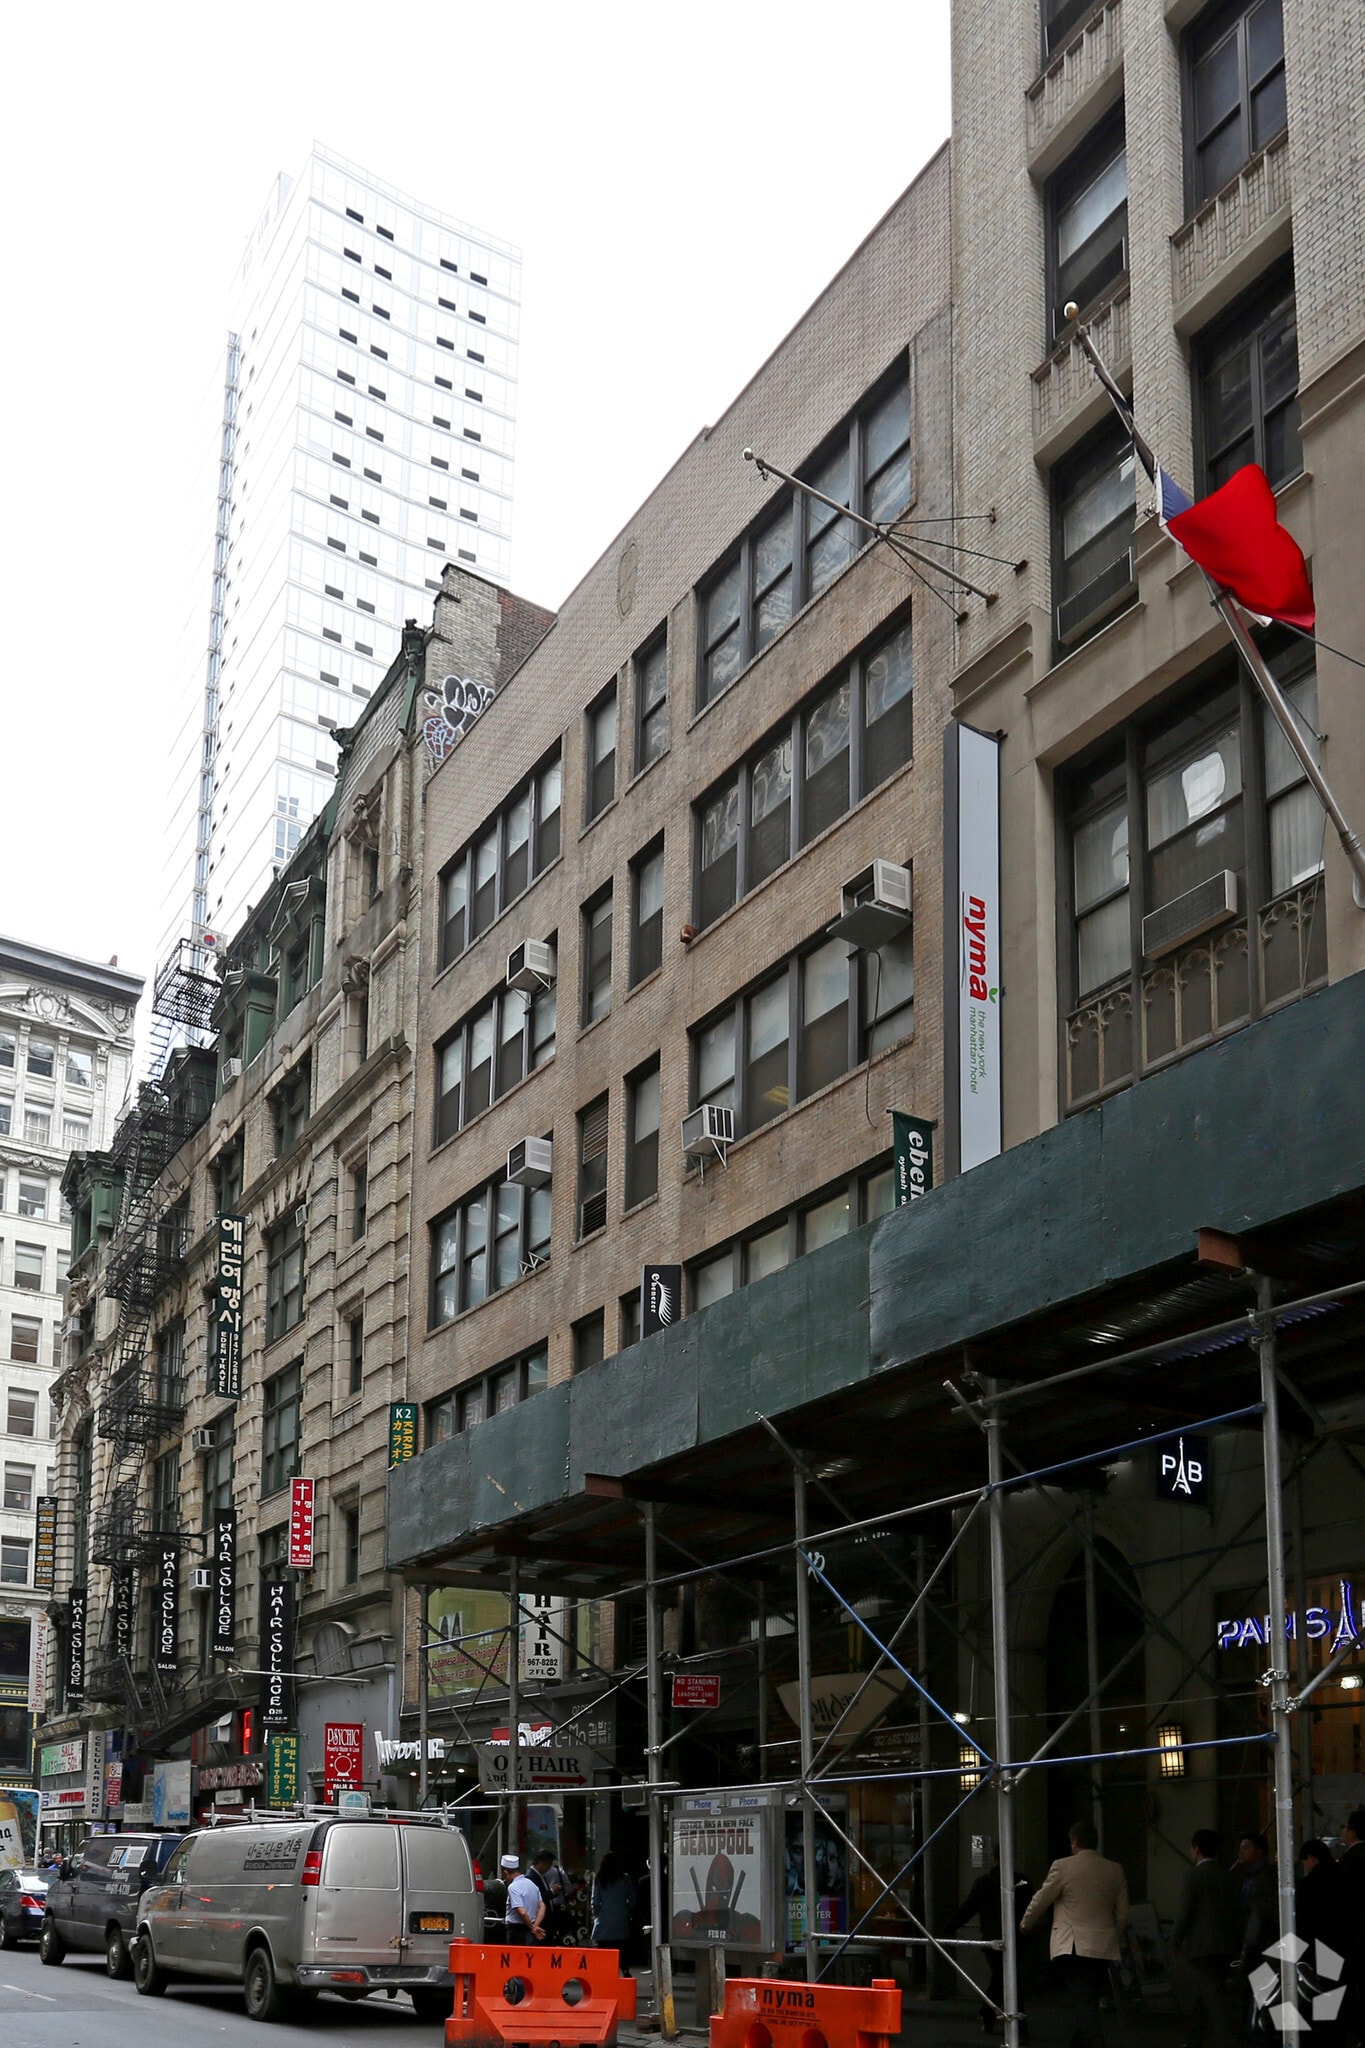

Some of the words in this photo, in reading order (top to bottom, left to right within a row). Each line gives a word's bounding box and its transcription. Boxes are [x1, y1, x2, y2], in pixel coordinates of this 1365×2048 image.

[978, 1010, 986, 1028] the
[970, 1065, 978, 1094] hotel
[978, 1052, 987, 1078] york
[899, 1156, 908, 1190] eyelash
[219, 1219, 242, 1331] 에덴여행사
[219, 1358, 227, 1392] TRAVEL
[403, 1422, 413, 1461] KARAO
[220, 1523, 232, 1562] HAIR
[163, 1553, 175, 1588] HAIR
[72, 1600, 82, 1629] HAIR
[219, 1568, 231, 1635] COLLAGE
[270, 1586, 283, 1628] HAIR
[117, 1614, 128, 1654] COLLA
[162, 1593, 174, 1654] COLLAGE
[534, 1595, 552, 1656] HAIR
[71, 1634, 82, 1685] COLLAGE
[270, 1633, 283, 1706] COLLAGE
[62, 1744, 74, 1756] SALE
[327, 1728, 360, 1746] PSYCHIC
[415, 1738, 445, 1760] BR
[93, 1736, 101, 1781] CELLULAR
[284, 1737, 296, 1796] 에덴여행사
[529, 1756, 580, 1773] HAIR
[91, 1786, 99, 1814] PHONE
[694, 1800, 711, 1808] Phone
[739, 1797, 758, 1806] Phone
[704, 1820, 715, 1828] HAS
[717, 1820, 721, 1828] A
[723, 1820, 736, 1828] NEW
[739, 1818, 754, 1827] FACE
[680, 1828, 754, 1856] DEADPOOL
[789, 1911, 831, 1919] MOTER
[708, 1930, 719, 1938] FEB
[720, 1930, 726, 1938] 12
[500, 1952, 587, 1970] NYMA
